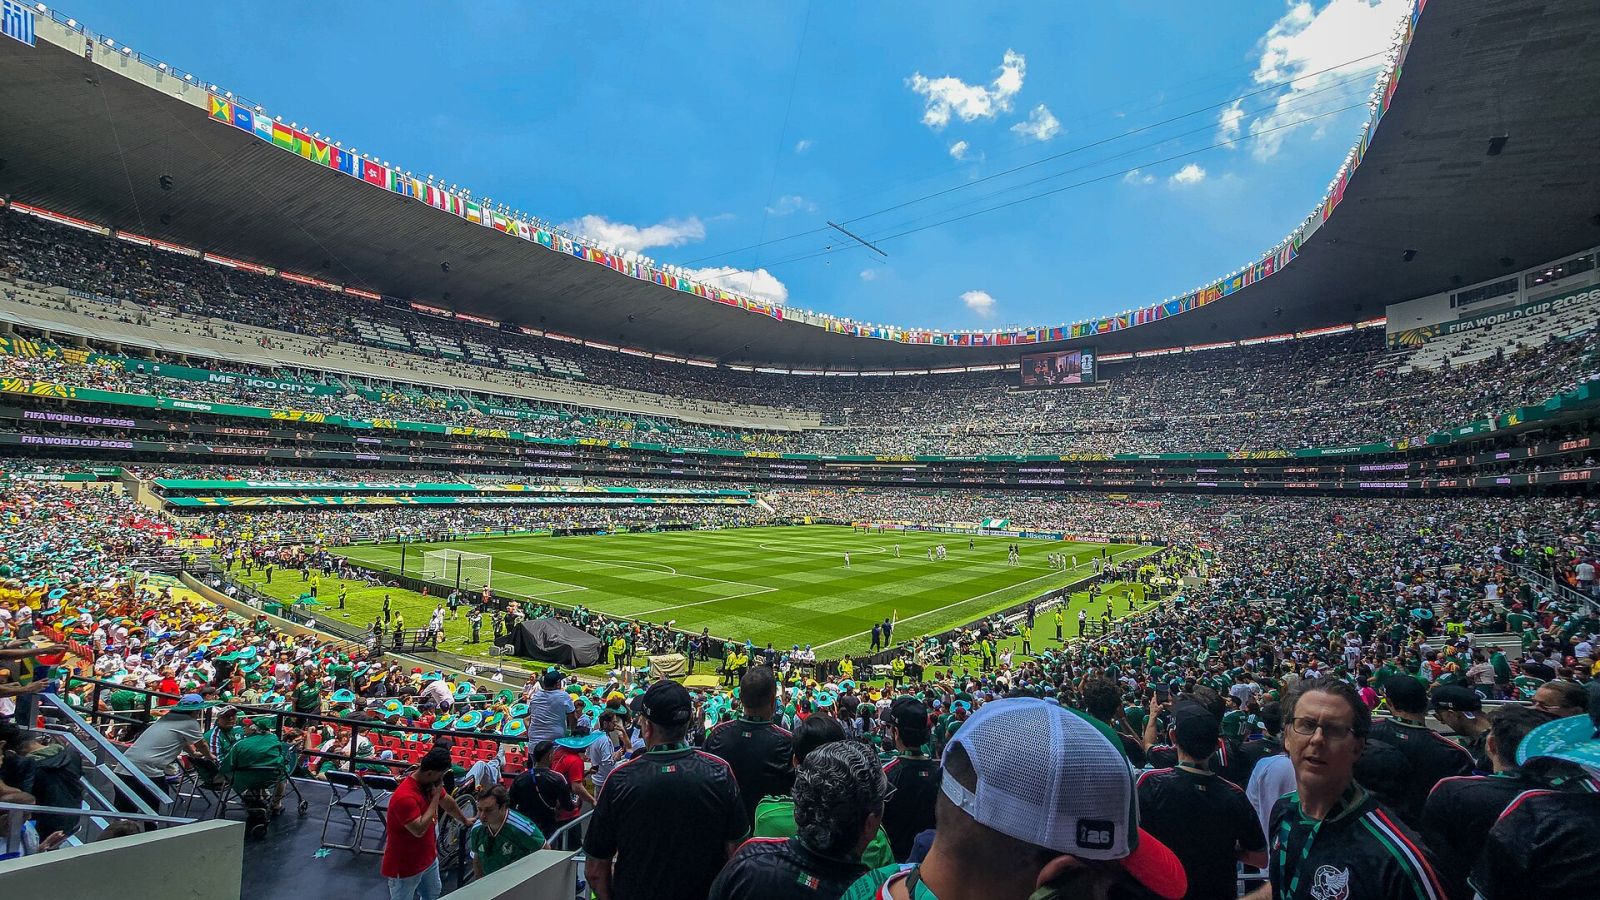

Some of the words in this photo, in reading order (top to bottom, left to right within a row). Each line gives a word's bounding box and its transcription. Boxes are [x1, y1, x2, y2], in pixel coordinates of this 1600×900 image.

[1450, 321, 1474, 333] FIFA
[1476, 310, 1522, 327] WORLD
[1525, 302, 1550, 316] CUP
[1552, 289, 1600, 310] 2026
[24, 411, 46, 420] FIFA
[46, 413, 82, 422] WORLD
[82, 416, 102, 424] CUP
[102, 418, 136, 426] 2026
[22, 436, 44, 444] FIFA
[44, 437, 80, 446] WORLD
[1026, 532, 1055, 540] Hisense
[1088, 830, 1110, 844] 26
